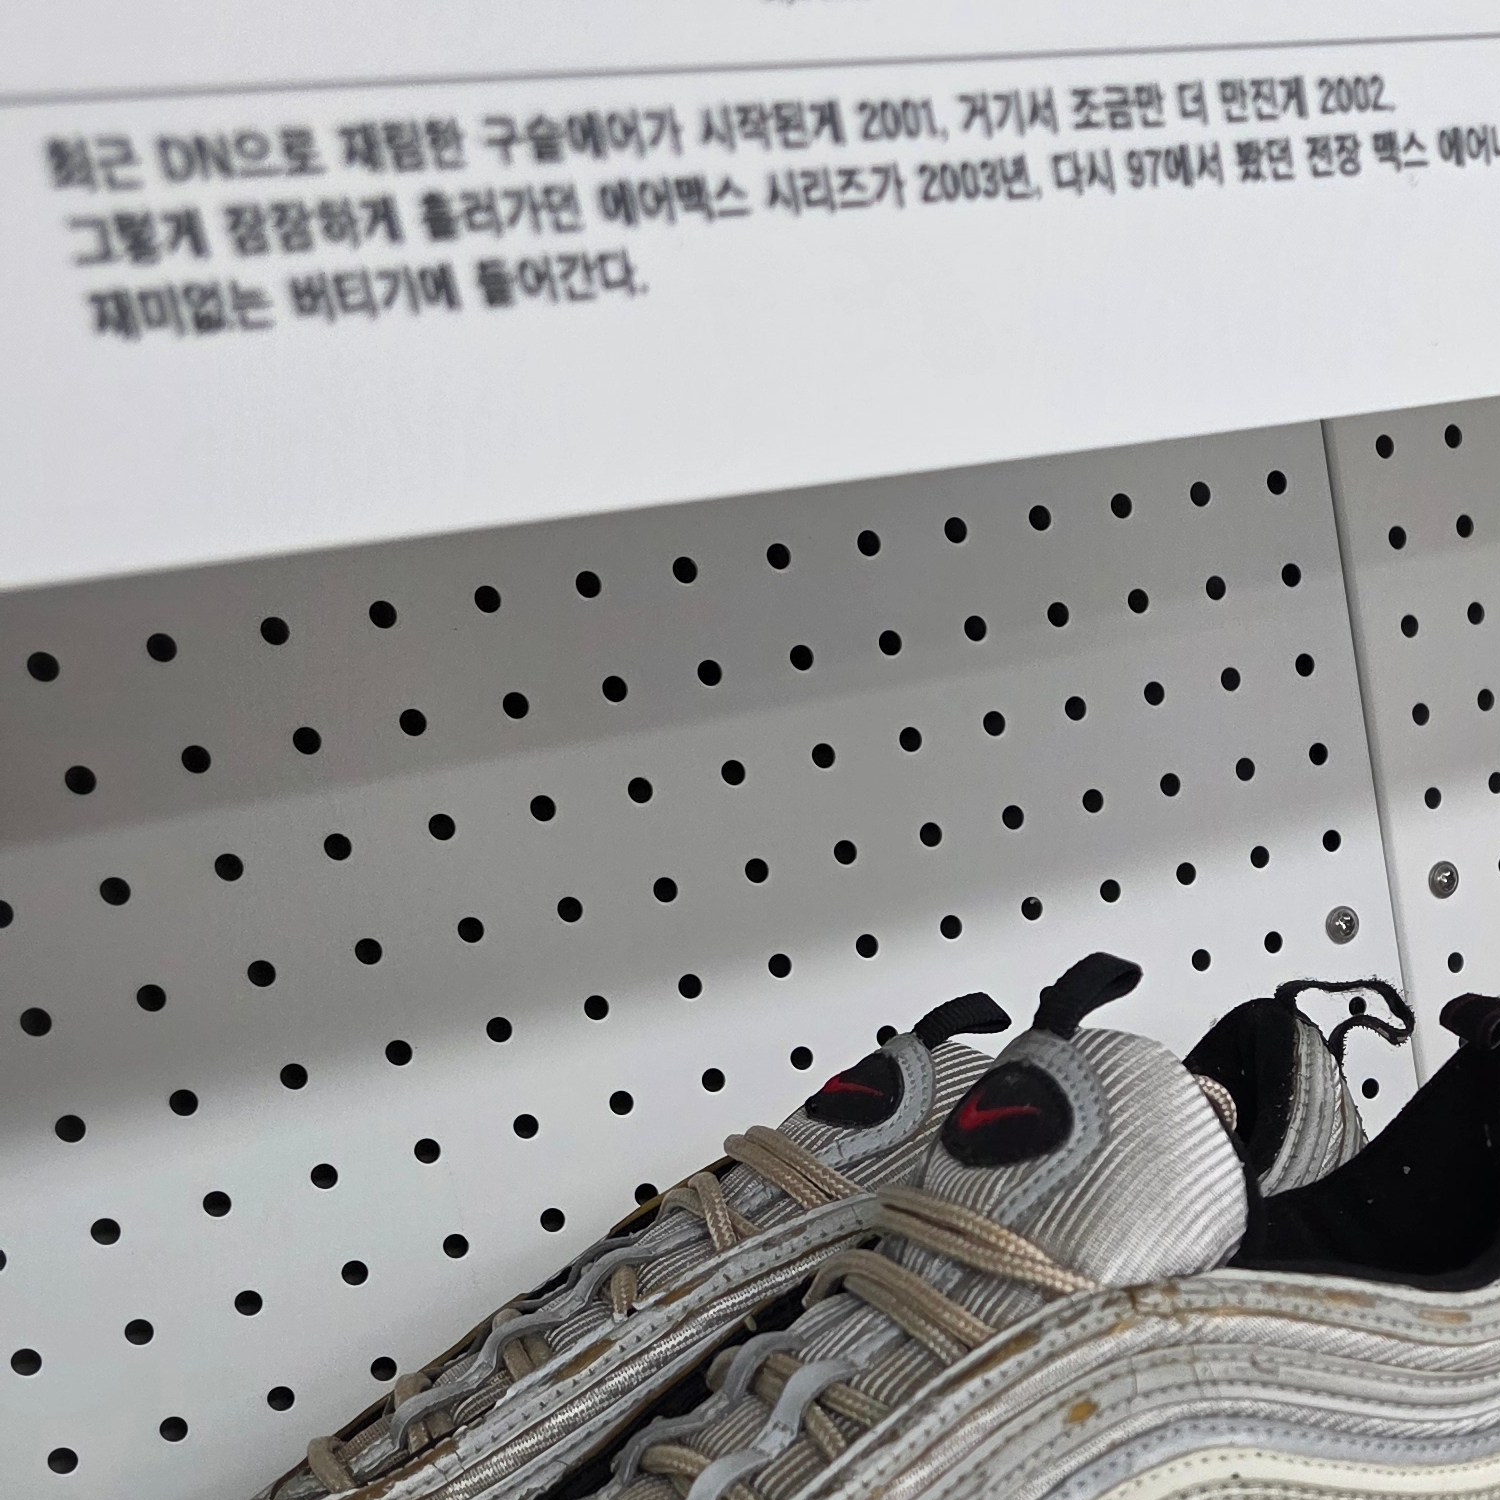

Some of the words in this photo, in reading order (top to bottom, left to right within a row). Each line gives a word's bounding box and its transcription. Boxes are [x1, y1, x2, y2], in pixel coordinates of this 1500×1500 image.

[156, 126, 326, 183] DN으로
[482, 103, 684, 166] 구슬에어가
[699, 97, 846, 154] 시작된게
[858, 97, 950, 144] 2001,
[957, 86, 1060, 140] 거기서
[1070, 81, 1167, 131] 조금만
[1176, 79, 1209, 126] 더
[1217, 74, 1308, 124] 만진게
[64, 205, 213, 266] 그렇게
[224, 192, 405, 256] 잠잠하게
[420, 181, 584, 243] 흘러가던
[598, 173, 753, 228] 에어맥스
[767, 160, 907, 217] 시리즈가
[918, 152, 1044, 204] 2003년,
[1050, 147, 1117, 196] 다시
[1127, 139, 1224, 189] 97에서
[1236, 137, 1296, 183] 봤던
[1305, 131, 1362, 179] 전장
[1372, 126, 1429, 173] 맥스
[87, 279, 275, 341] 재미없는
[287, 260, 463, 324] 버티기에
[476, 247, 652, 310] 들어간다.
